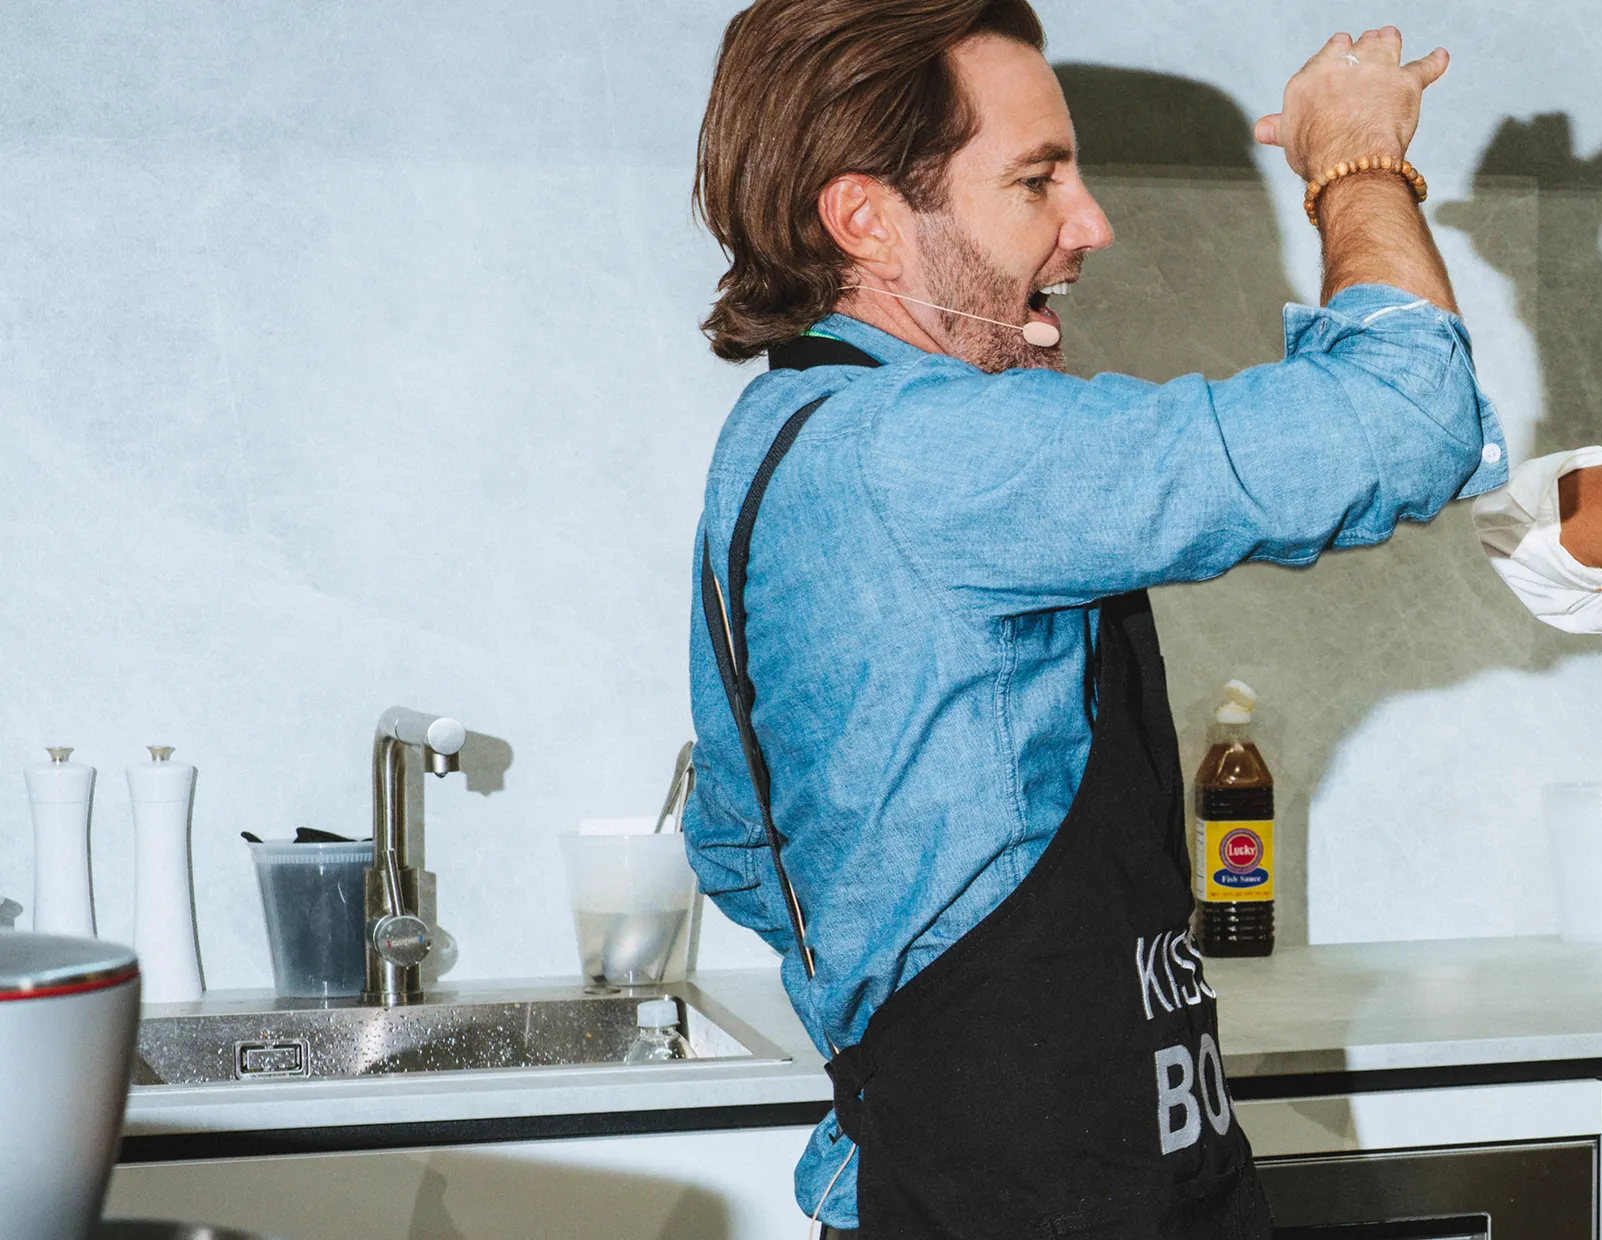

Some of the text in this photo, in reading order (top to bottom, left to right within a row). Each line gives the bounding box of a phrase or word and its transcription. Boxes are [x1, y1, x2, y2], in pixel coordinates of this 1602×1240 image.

[1228, 843, 1257, 857] Lucky
[1221, 874, 1262, 884] Fish Sauce
